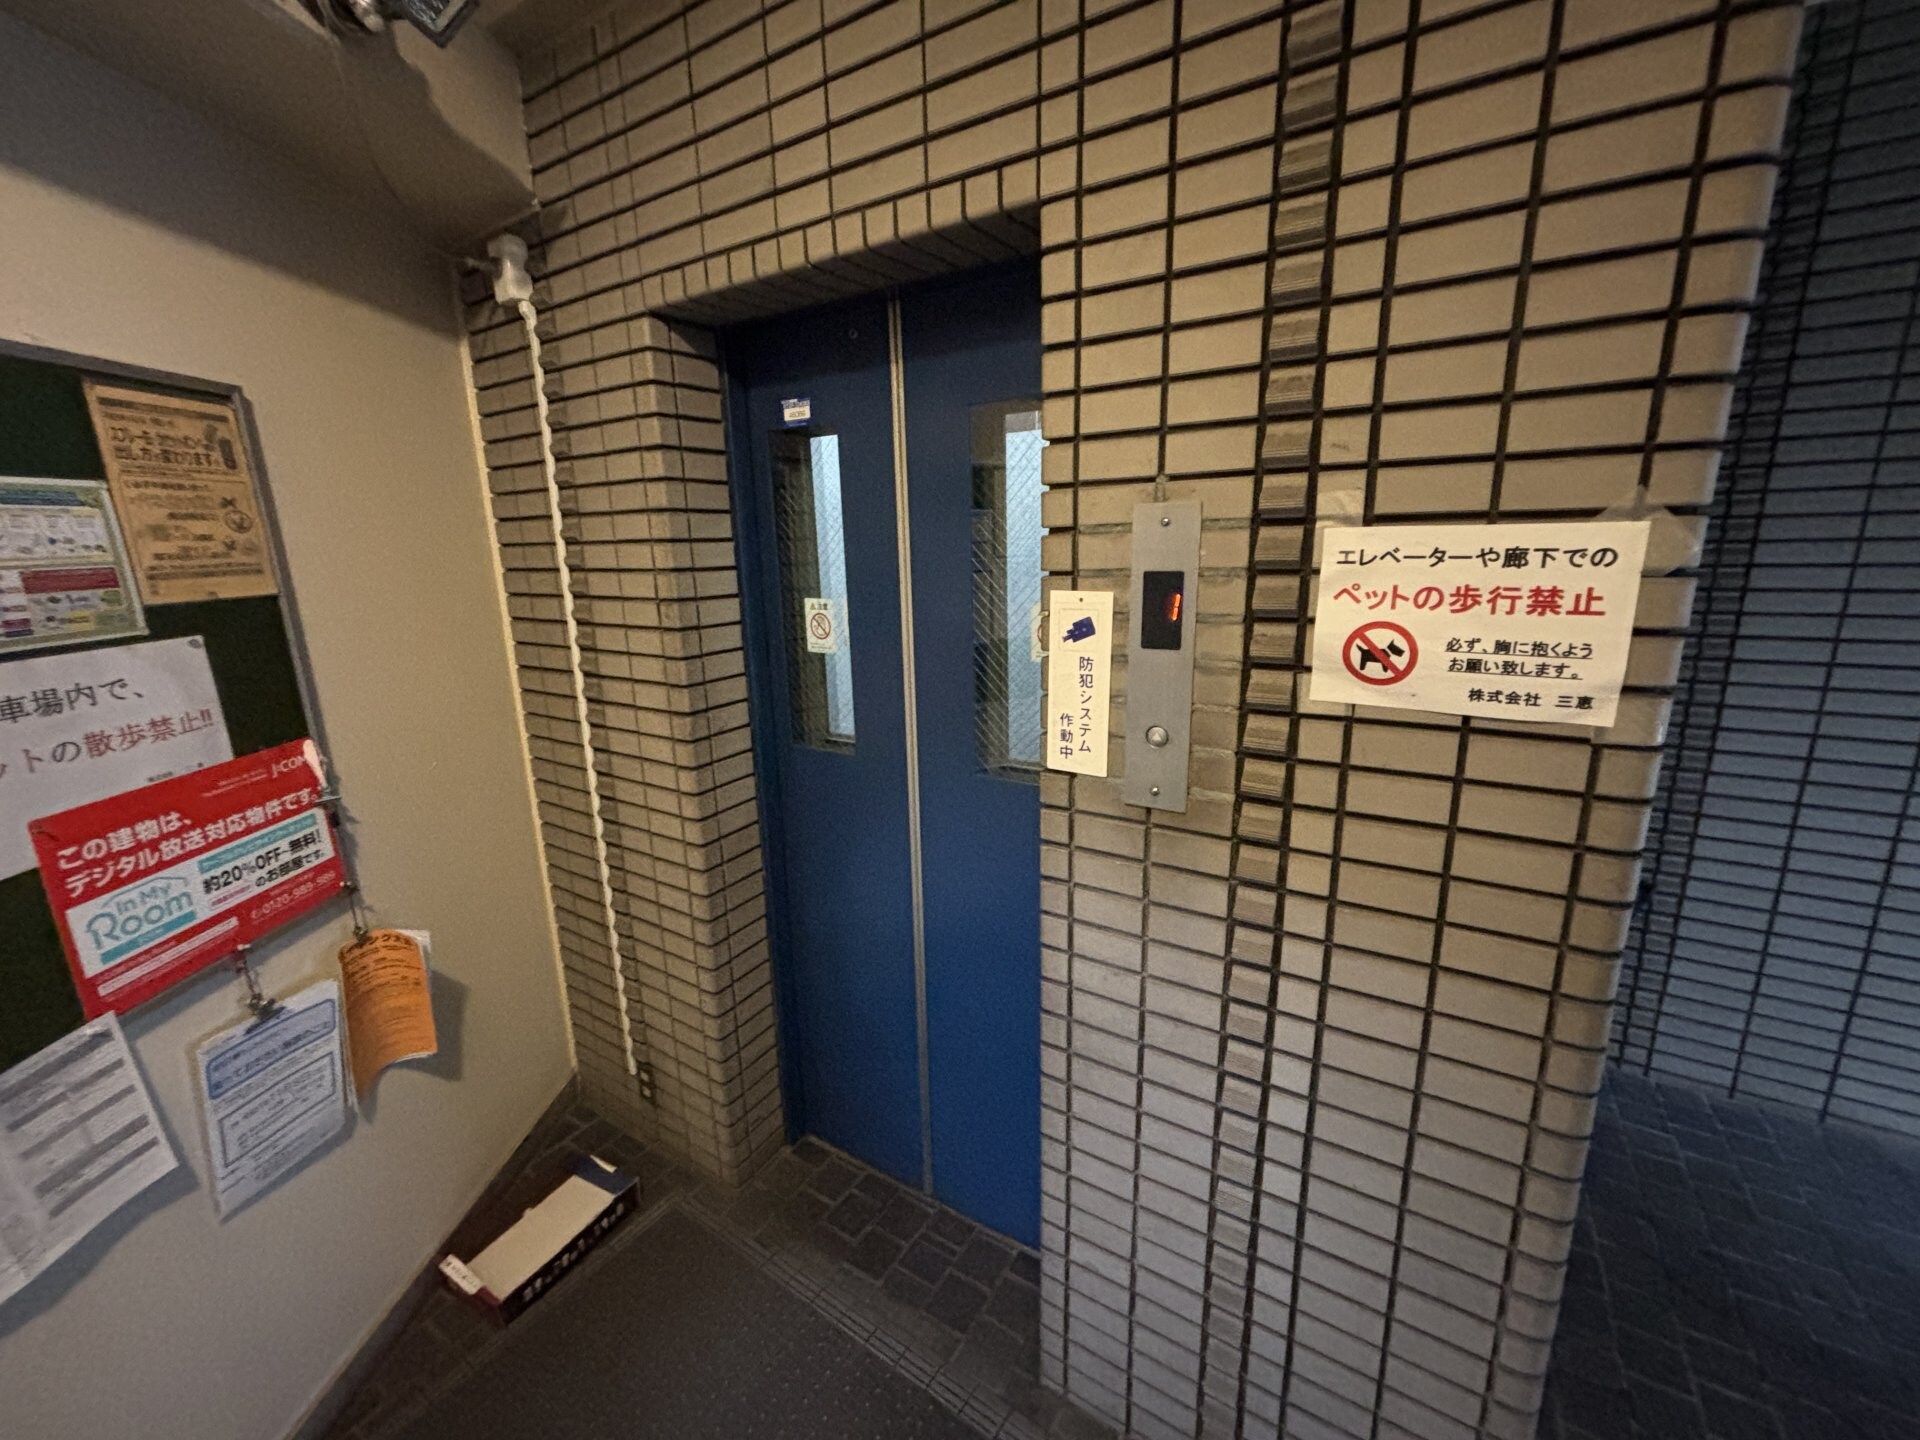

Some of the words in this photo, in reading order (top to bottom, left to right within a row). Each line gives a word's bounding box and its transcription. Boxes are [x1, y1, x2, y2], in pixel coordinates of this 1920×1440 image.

[1336, 545, 1619, 569] エレベーターや廊下での
[1170, 593, 1181, 621] 1
[1333, 583, 1606, 617] ペットの歩行禁止
[1445, 636, 1594, 659] 必ず、胸に抱くよう
[1449, 656, 1579, 680] お願い致します。
[1078, 655, 1094, 753] 防犯システム
[1468, 687, 1542, 707] 株式会社
[1059, 712, 1074, 759] 作動中
[57, 811, 192, 870] この建物は、
[65, 787, 318, 898] デジタル放送対応物件です。
[85, 891, 193, 950] Room
[116, 900, 137, 916] In
